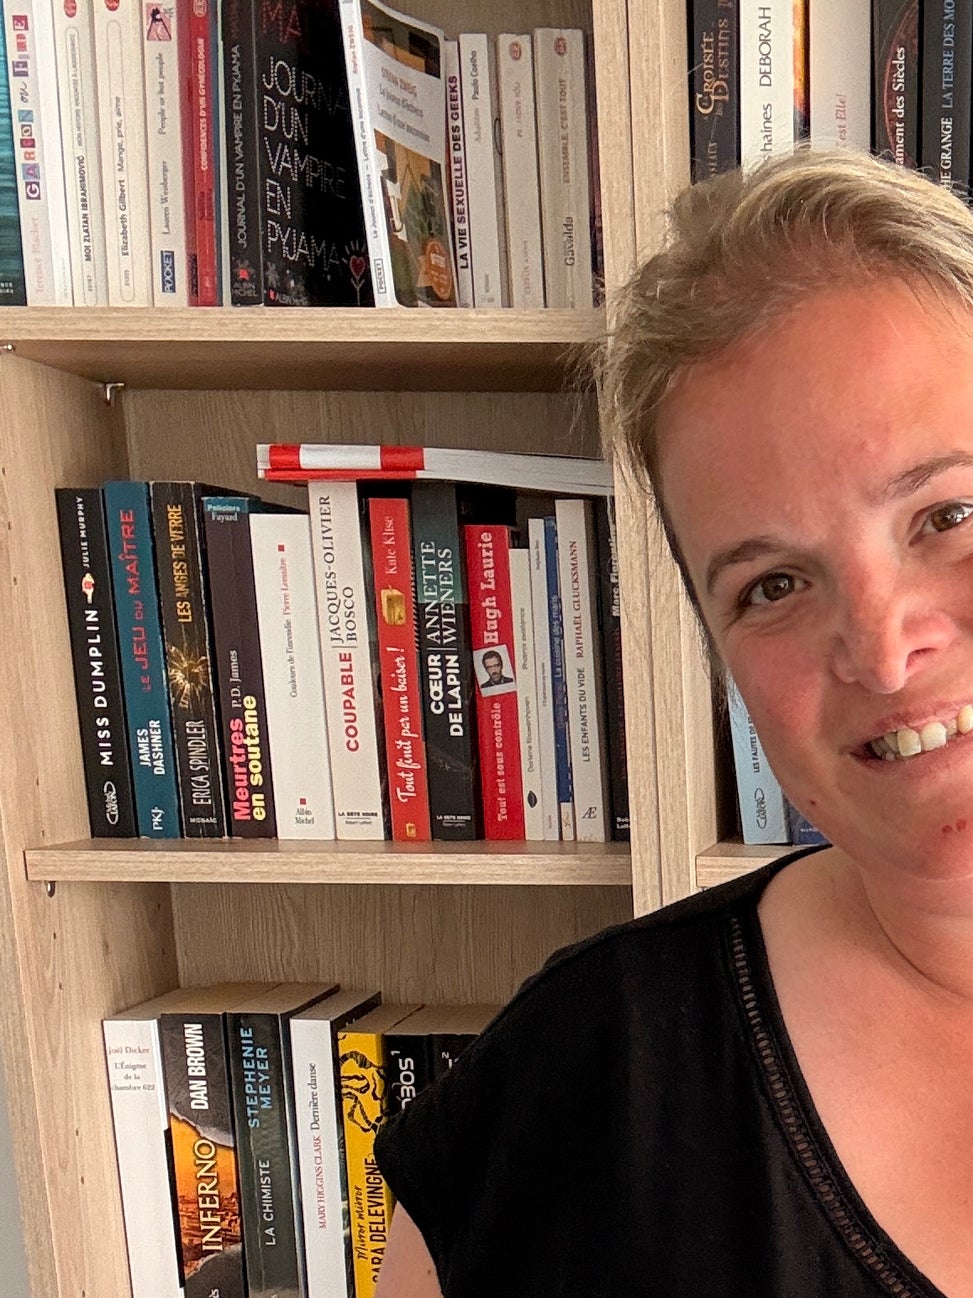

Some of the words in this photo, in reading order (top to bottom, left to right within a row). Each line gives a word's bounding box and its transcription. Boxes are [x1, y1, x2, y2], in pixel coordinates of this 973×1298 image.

[759, 7, 772, 87] DEBORAH
[943, 24, 955, 46] DES
[231, 45, 242, 91] PYJAMA
[893, 47, 906, 91] Siècles
[942, 50, 954, 89] TERRE
[448, 76, 458, 121] GEEKS
[893, 96, 905, 118] des
[233, 112, 244, 160] VAMPIRE
[450, 125, 461, 151] DES
[118, 179, 127, 211] Gilbert
[454, 156, 466, 224] SEXUELLE
[82, 213, 91, 242] ZLATAN
[118, 214, 129, 256] Elizabeth
[458, 228, 467, 249] VIE
[460, 253, 469, 269] LA
[76, 497, 88, 537] MURPHY
[211, 512, 238, 523] Fayard
[382, 516, 396, 545] Klise
[78, 541, 90, 568] JULIE
[318, 496, 343, 643] JACQUES-OLIVIER
[384, 549, 398, 574] Kate
[478, 532, 496, 590] Laurie
[420, 541, 442, 644] ANNETTE
[438, 548, 457, 644] WIENERS
[569, 541, 581, 611] GLUCKSMANN
[177, 601, 193, 622] LES
[342, 587, 358, 641] BOSCO
[482, 596, 502, 644] Hugh
[84, 609, 109, 708] DUMPLIN
[132, 627, 149, 670] JEU
[227, 650, 240, 682] James
[338, 652, 360, 752] COUPABLE
[426, 654, 445, 714] CŒUR
[444, 655, 462, 708] LAPIN
[397, 695, 410, 713] un
[448, 713, 464, 737] DE
[579, 704, 589, 744] ENFANTS
[96, 717, 114, 765] MISS
[149, 720, 166, 775] DASHNER
[186, 720, 209, 771] SPINDLER
[242, 696, 263, 786] soutane
[396, 715, 418, 738] par
[137, 729, 151, 767] JAMES
[396, 740, 421, 769] finit
[581, 747, 590, 762] LES
[190, 775, 212, 805] ERICA
[229, 719, 251, 820] Meurtres
[396, 771, 418, 803] Tout
[249, 794, 267, 820] en
[184, 1024, 207, 1076] BROWN
[189, 1080, 209, 1109] DAN
[240, 1028, 260, 1127] STEPHENIE
[257, 1047, 273, 1109] MEYER
[194, 1139, 224, 1250] INFERNO
[259, 1160, 274, 1221] CHIMISTE
[265, 1227, 277, 1245] LA
